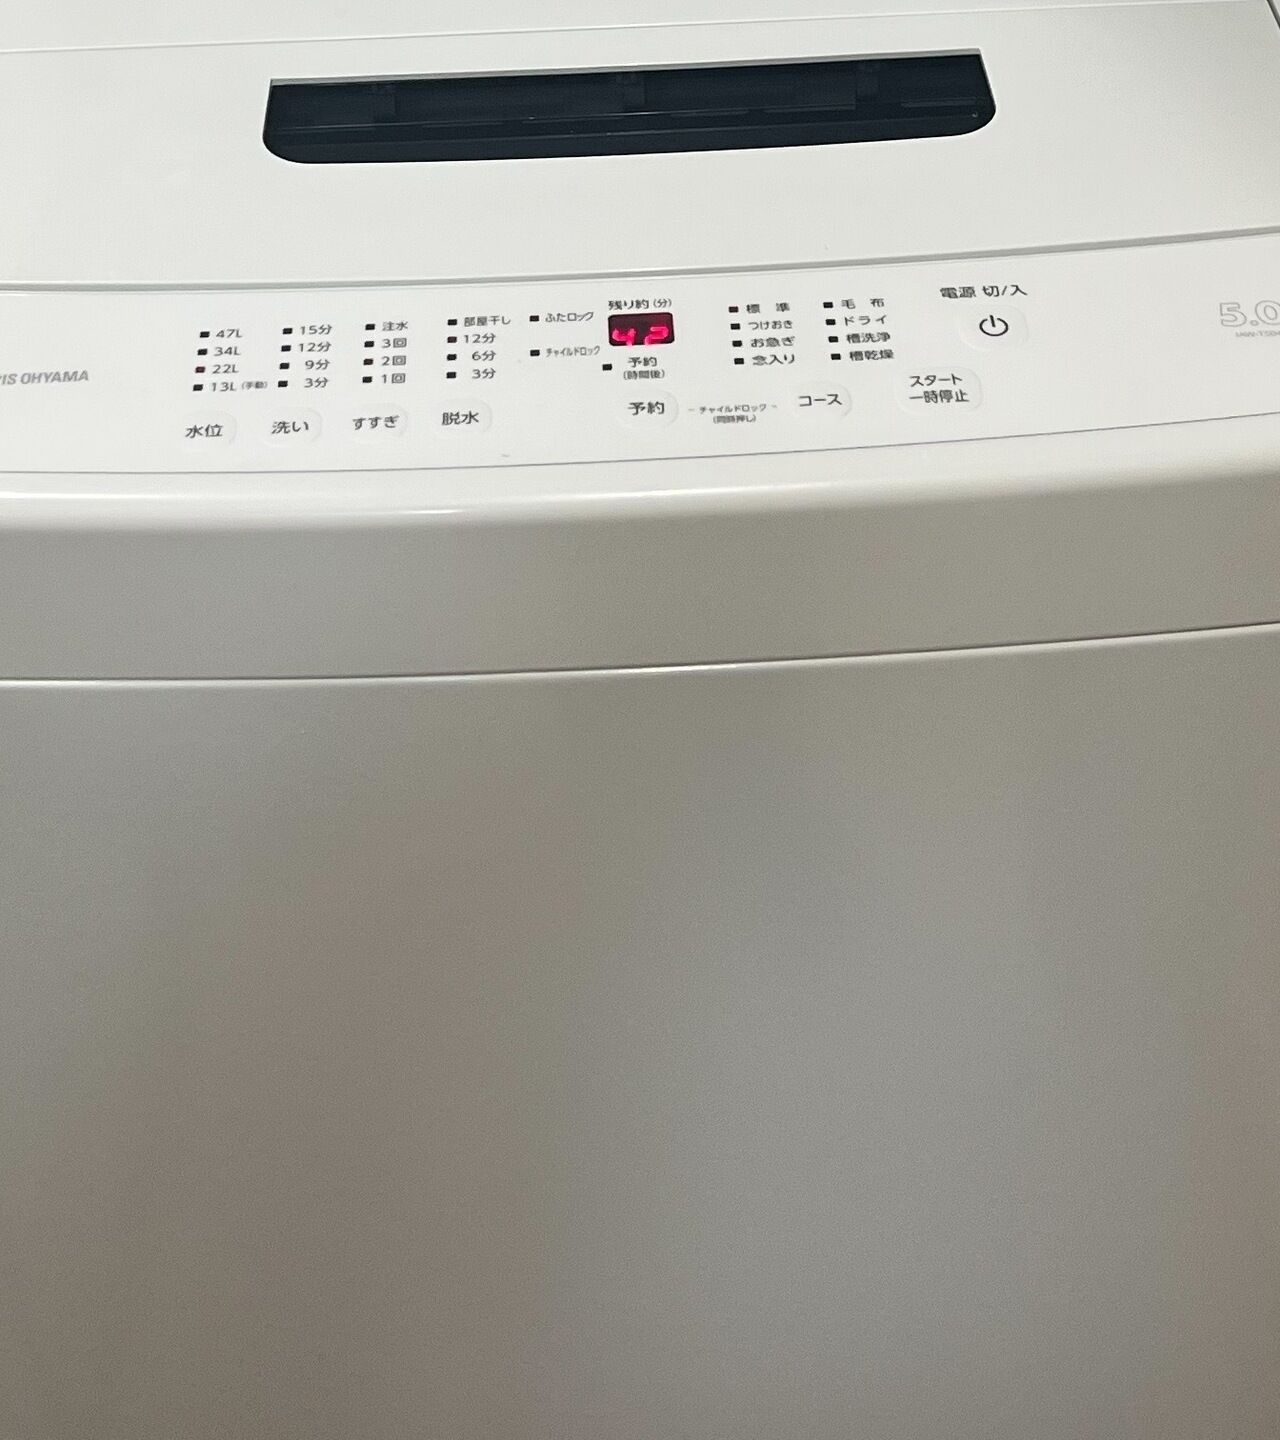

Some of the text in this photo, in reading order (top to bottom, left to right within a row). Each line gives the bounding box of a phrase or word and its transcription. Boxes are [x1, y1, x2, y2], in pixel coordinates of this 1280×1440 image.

[939, 284, 1028, 299] 電源 切/入
[464, 315, 511, 327] 部屋干し
[545, 312, 594, 323] ふたロック
[844, 315, 887, 326] ドライ
[300, 324, 333, 335] 15分
[382, 320, 408, 331] 注水
[748, 320, 793, 331] つけおき
[216, 328, 243, 338] 47L
[464, 333, 496, 344] 12分
[846, 332, 891, 344] 槽洗浄
[298, 341, 332, 352] 12分
[381, 337, 407, 349] 3回
[750, 336, 795, 348] お急ぎ
[214, 346, 241, 357] 34L
[472, 350, 496, 361] 6分
[305, 359, 330, 370] 9分
[381, 355, 407, 366] 2回
[627, 356, 657, 368] 予約
[752, 354, 795, 366] 念入り
[212, 364, 239, 374] 22L
[472, 368, 496, 379] 3分
[20, 370, 89, 384] OHYAMA
[304, 377, 329, 388] 3分
[381, 373, 406, 384] 1回
[909, 373, 963, 387] スタート
[212, 382, 236, 392] 13L
[798, 394, 843, 407] コース
[909, 389, 970, 404] 一時停止
[627, 401, 665, 416] 予約
[352, 415, 400, 430] すすぎ
[441, 410, 479, 426] 脱水
[185, 424, 223, 439] 水位
[271, 421, 309, 434] 洗い
